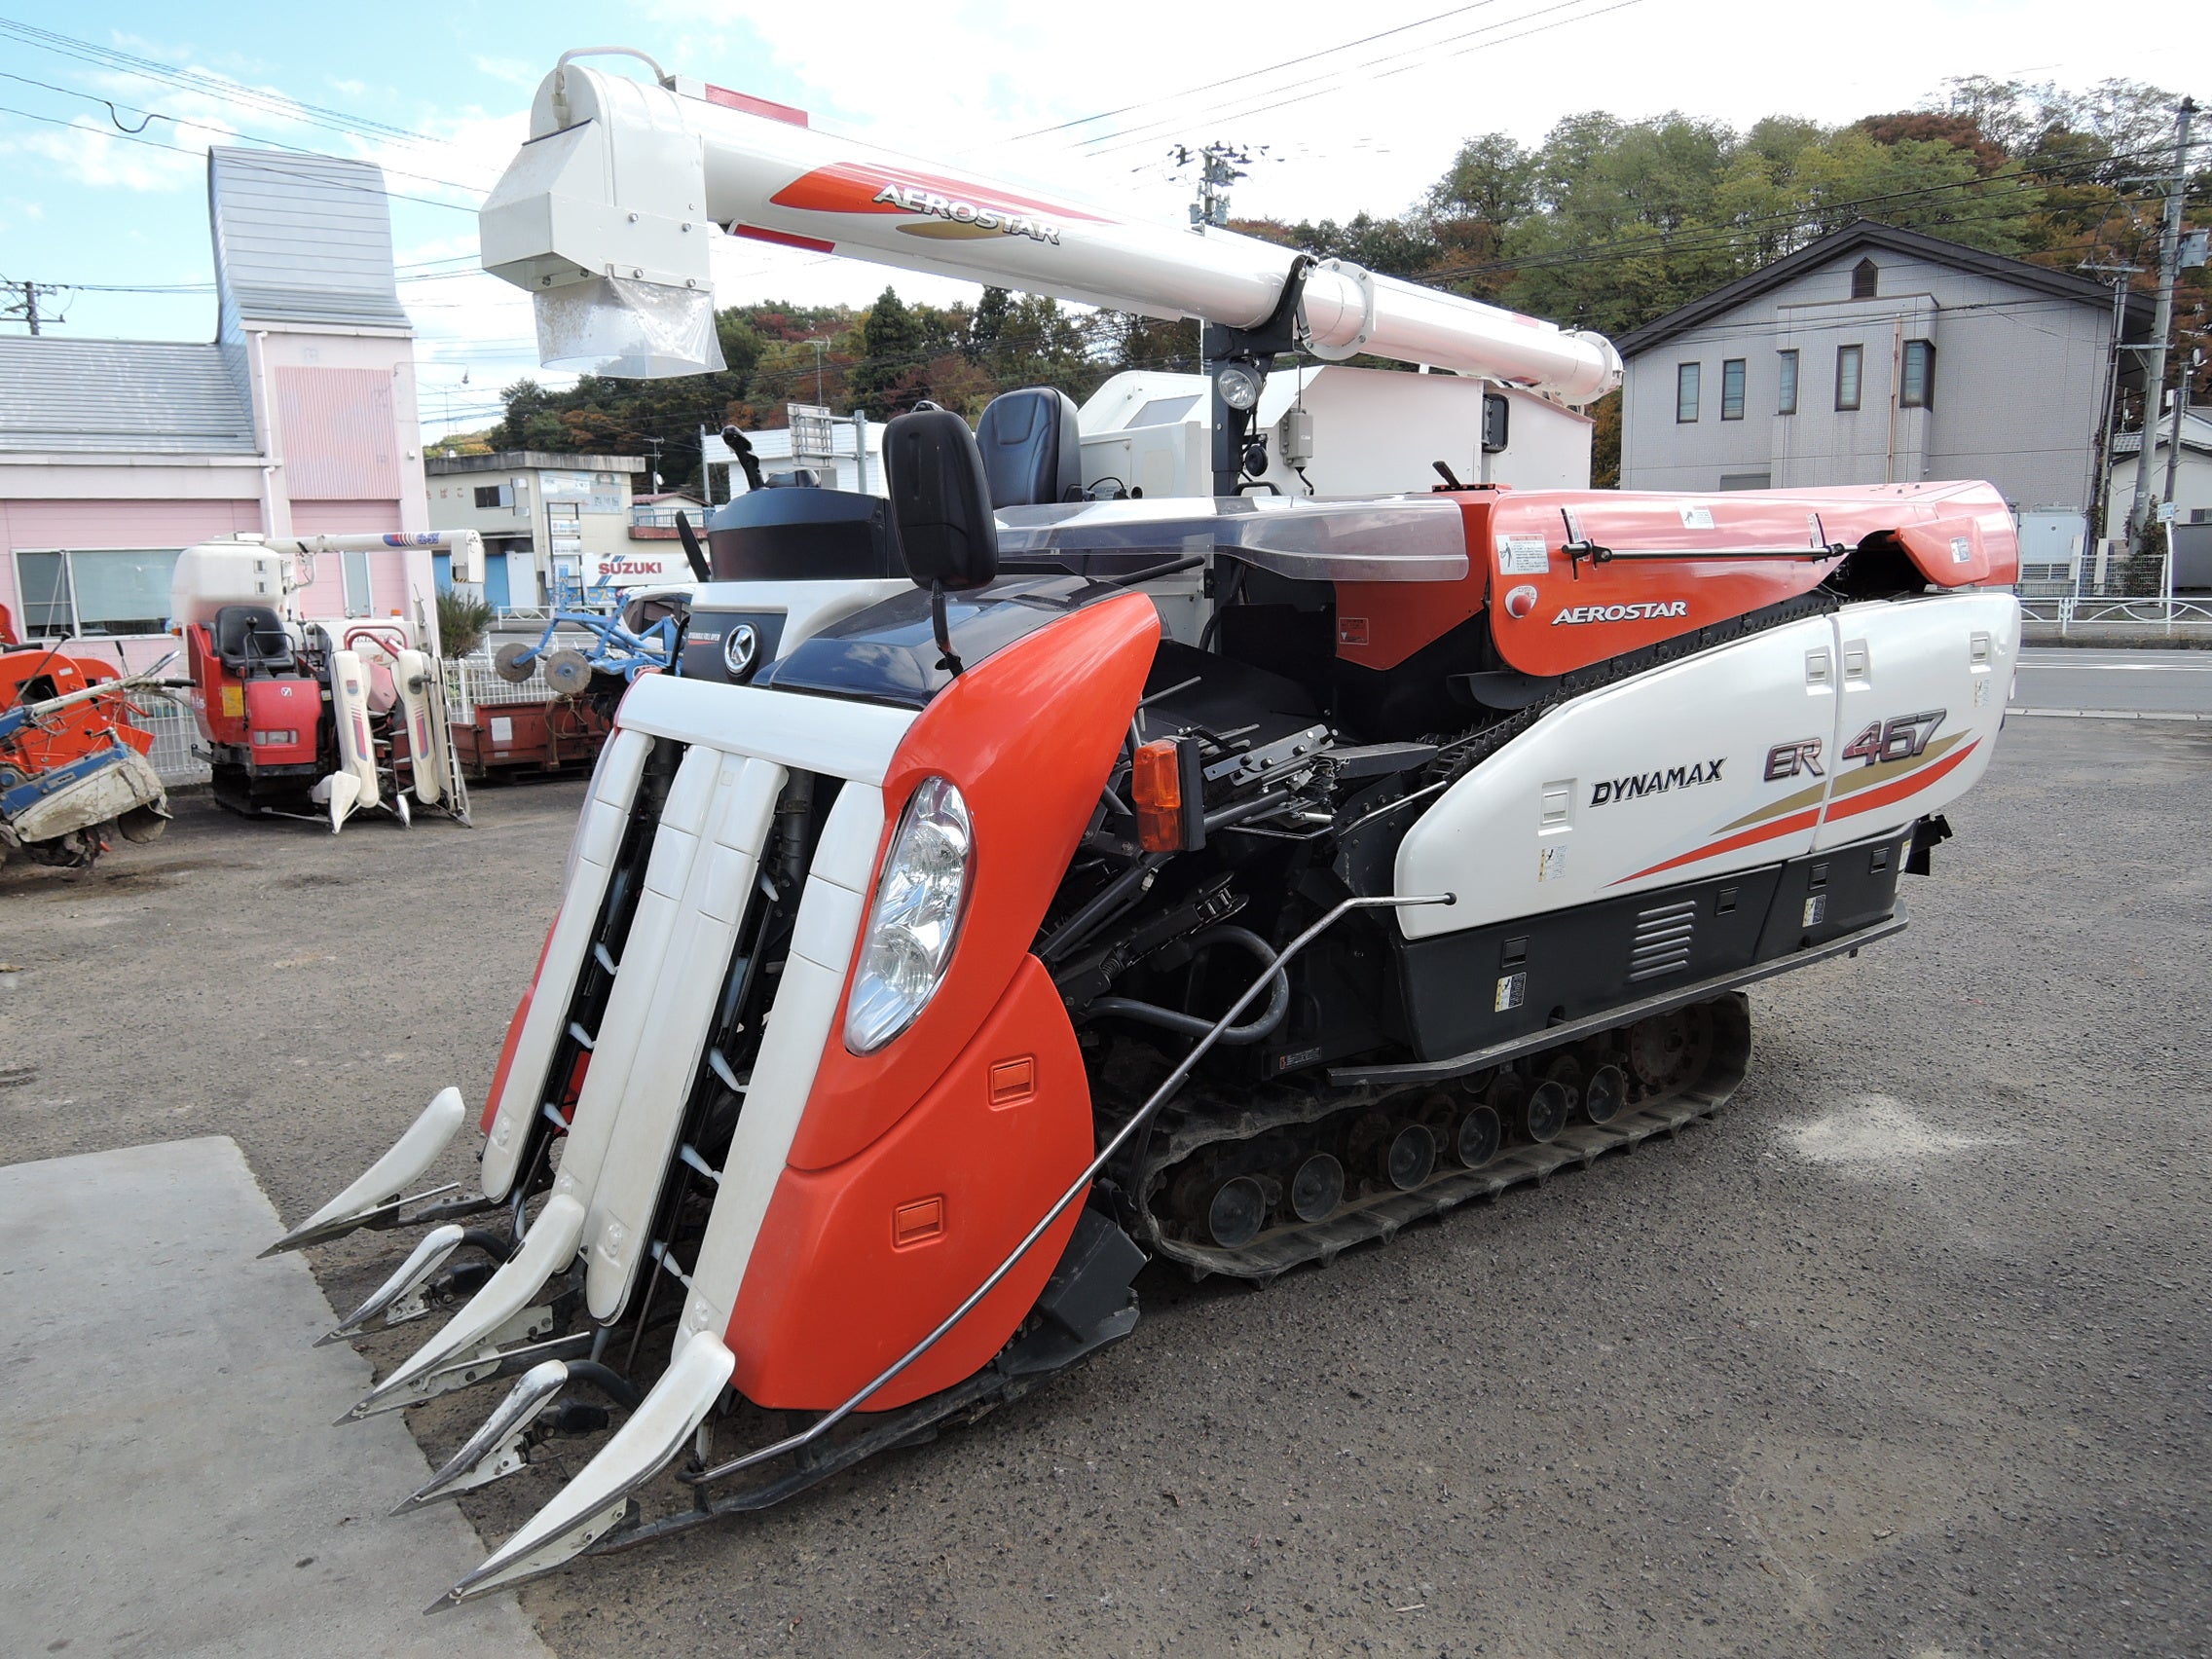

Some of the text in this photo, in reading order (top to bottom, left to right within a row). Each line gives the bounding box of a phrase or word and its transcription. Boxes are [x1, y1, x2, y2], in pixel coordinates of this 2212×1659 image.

[872, 183, 1060, 244] AEROSTAR
[598, 562, 662, 574] SUZUKI
[1551, 600, 1687, 625] AEROSTAR
[1764, 709, 1946, 782] ER 467
[1589, 756, 1728, 807] DYNAMAX
